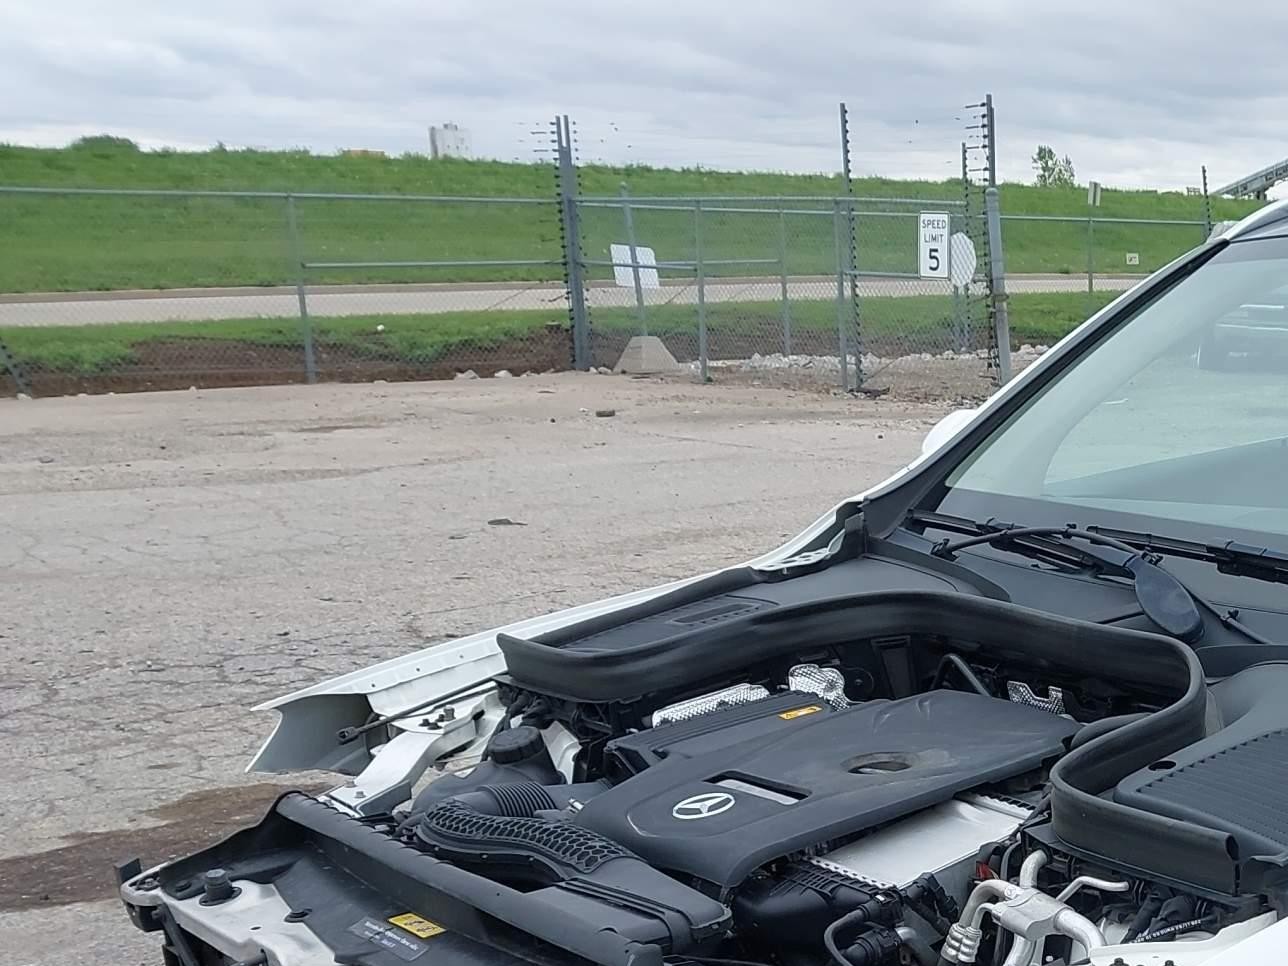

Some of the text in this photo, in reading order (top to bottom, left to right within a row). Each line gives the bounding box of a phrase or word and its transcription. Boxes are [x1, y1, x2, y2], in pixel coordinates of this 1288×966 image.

[922, 219, 946, 229] SPEED
[924, 233, 944, 243] LIMIT
[929, 248, 940, 271] 5
